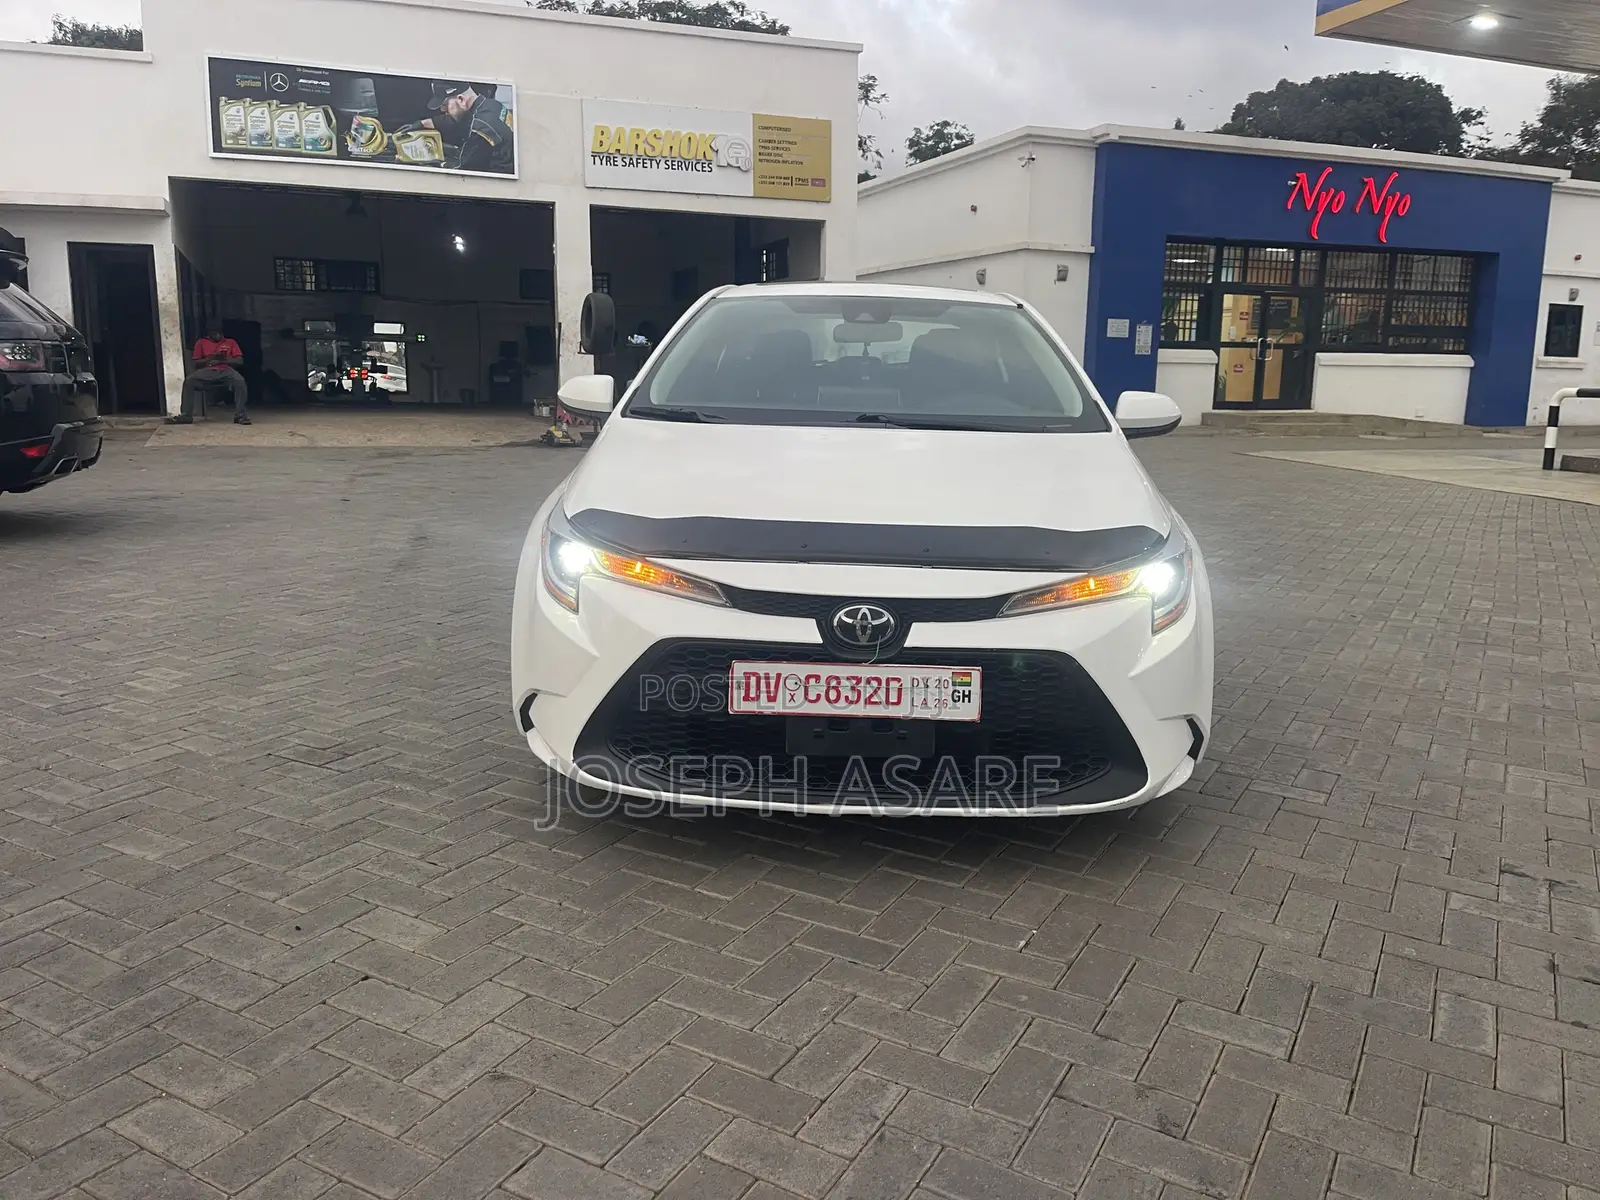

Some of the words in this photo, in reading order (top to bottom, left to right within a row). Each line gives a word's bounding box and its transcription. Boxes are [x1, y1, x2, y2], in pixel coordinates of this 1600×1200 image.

[591, 125, 717, 161] BARSHOK
[591, 155, 619, 167] TYRE
[621, 157, 662, 170] SAFETY
[664, 159, 713, 173] SERVICES
[1286, 167, 1346, 240] Nyo
[1355, 171, 1411, 244] Nyo
[742, 671, 782, 703] DV
[951, 689, 972, 704] GH
